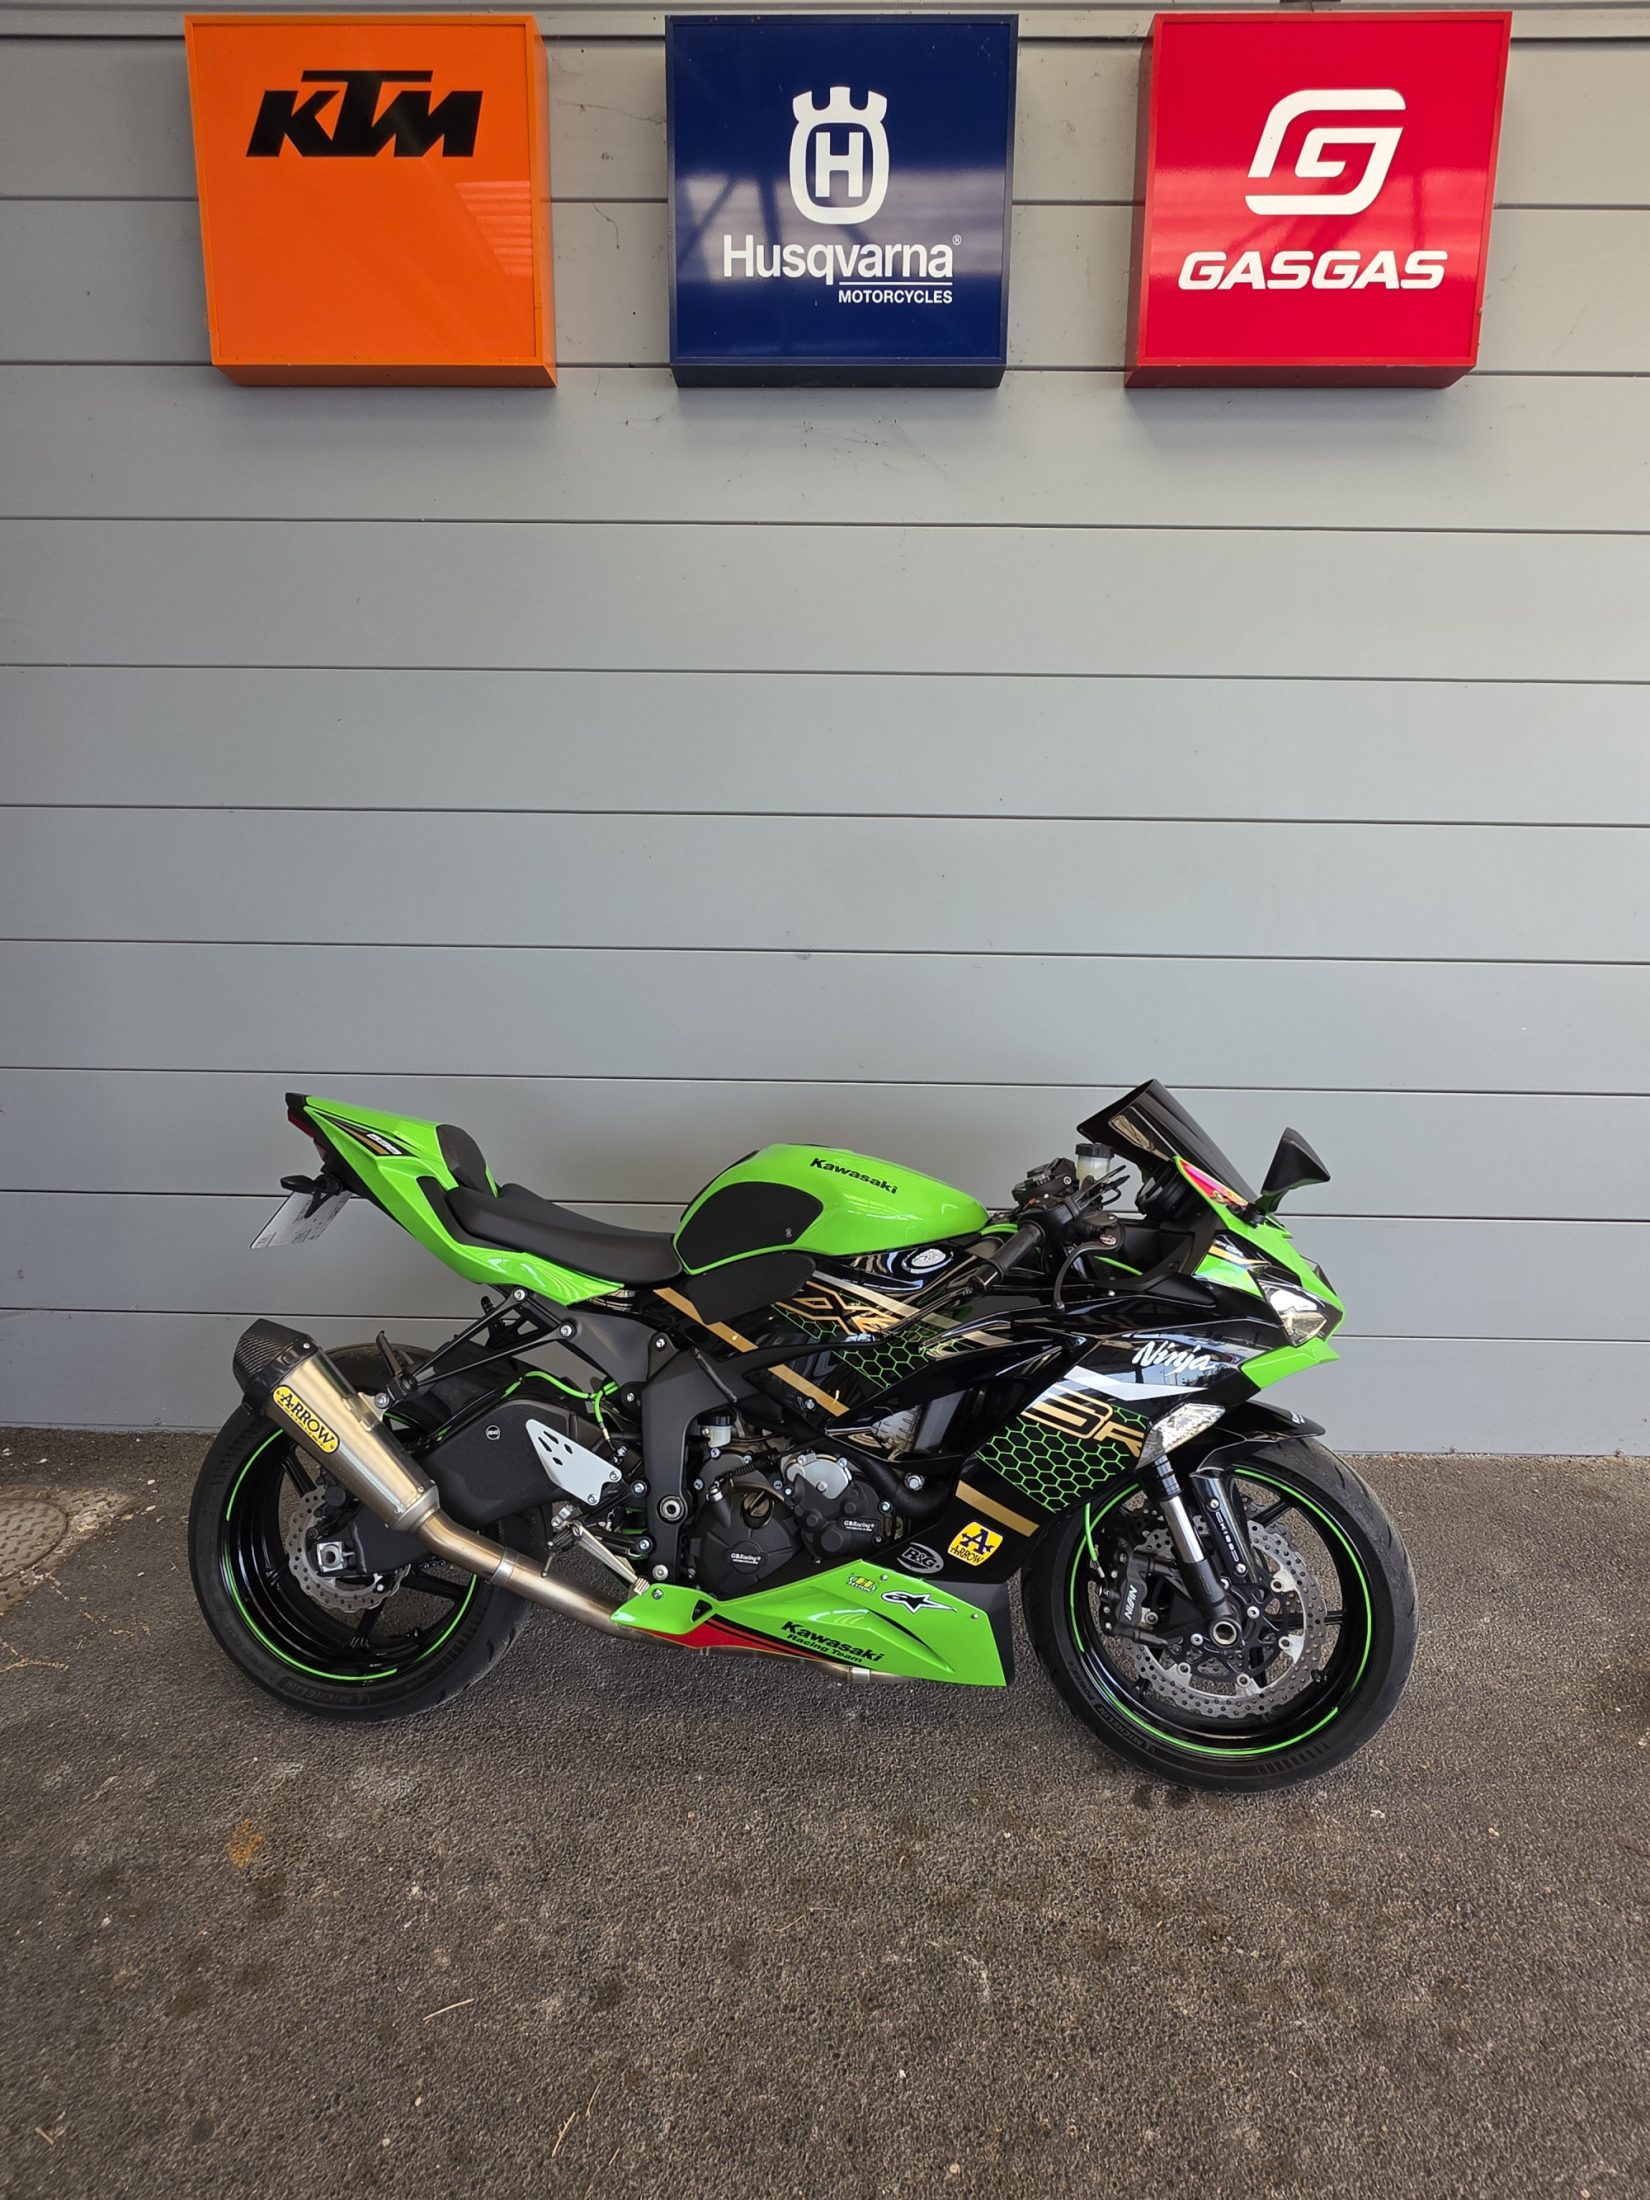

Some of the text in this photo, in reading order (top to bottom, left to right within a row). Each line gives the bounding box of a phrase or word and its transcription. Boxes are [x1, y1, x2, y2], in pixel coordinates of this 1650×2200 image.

[246, 70, 483, 157] KTM
[1178, 250, 1448, 290] GASGAS
[838, 290, 953, 304] MOTORCYCLES
[809, 1157, 898, 1195] Kawasaki
[1131, 1340, 1216, 1377] Ninja
[279, 1390, 335, 1445] ARROW
[903, 1548, 938, 1568] R&G
[949, 1546, 985, 1564] ARROW
[780, 1621, 886, 1662] Kawasaki
[786, 1634, 863, 1663] Racing Team
